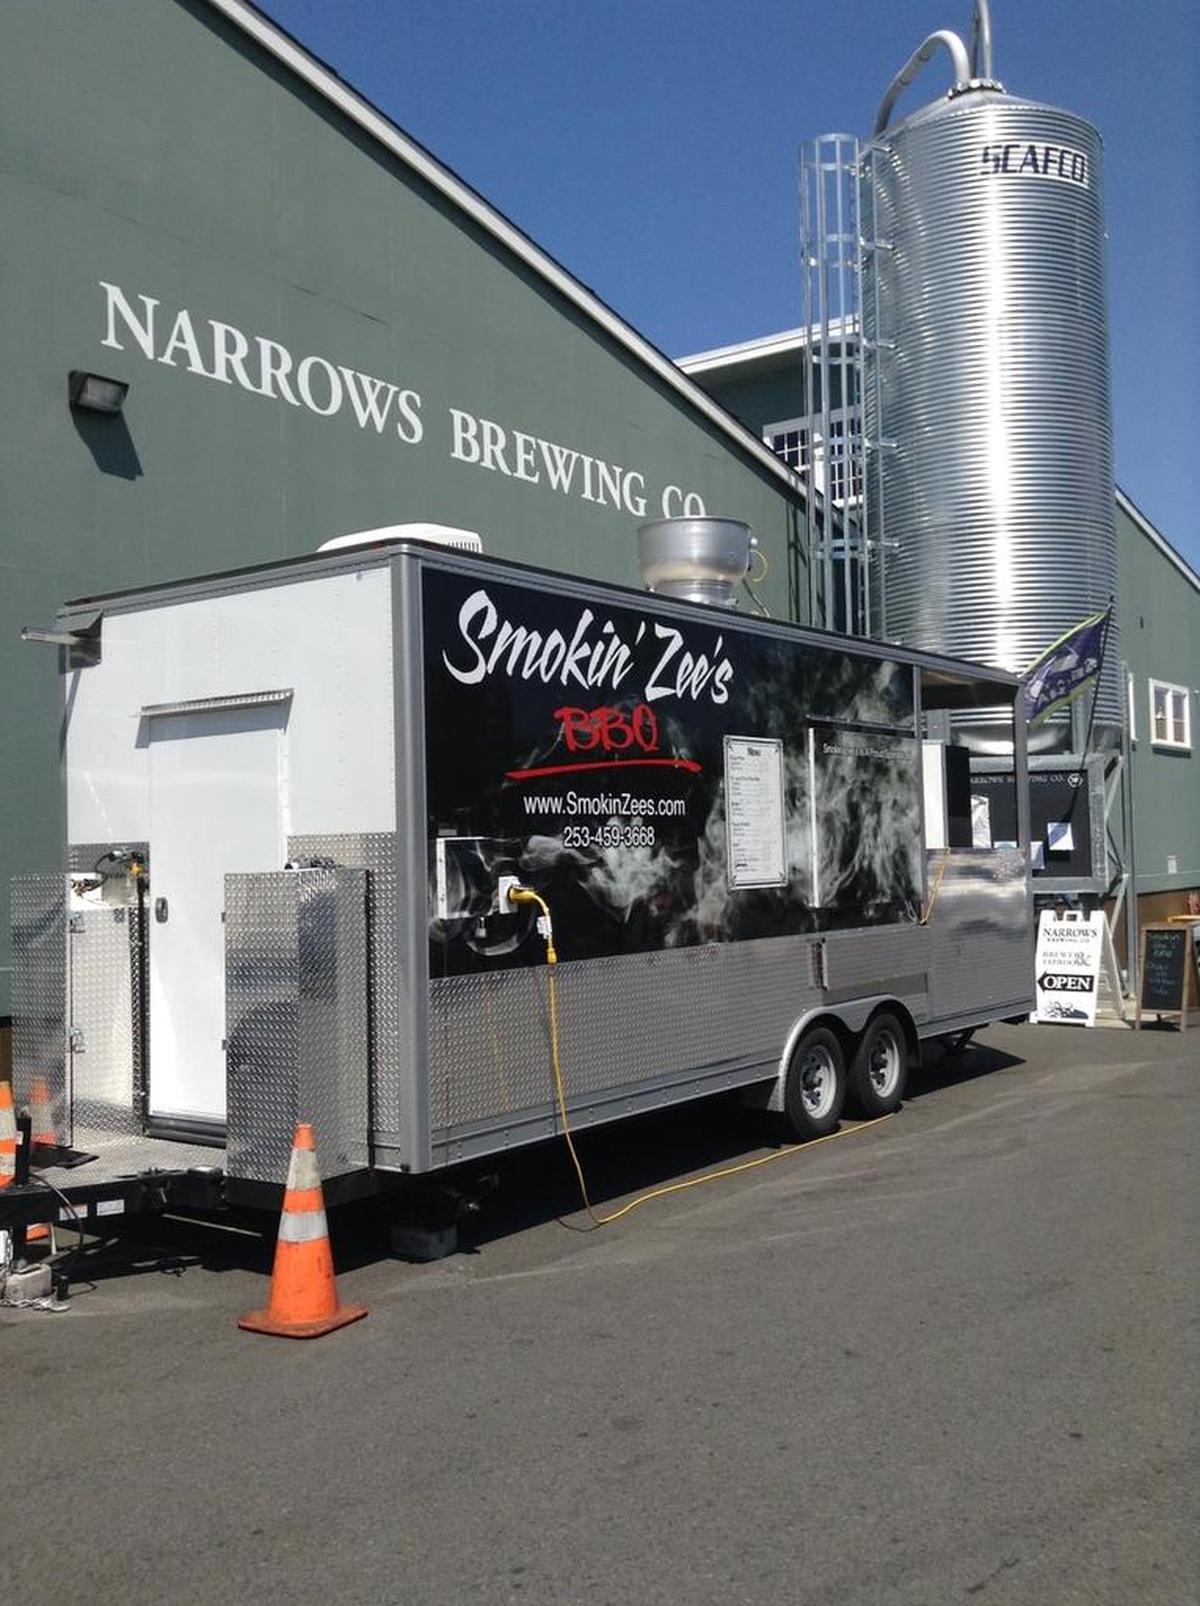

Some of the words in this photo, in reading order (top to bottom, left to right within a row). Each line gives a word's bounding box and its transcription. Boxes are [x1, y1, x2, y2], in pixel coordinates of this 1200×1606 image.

[981, 144, 1086, 183] SCAFCO
[99, 281, 424, 445] NARROWS
[450, 407, 648, 518] BREWING
[442, 588, 646, 690] Smokin'
[644, 622, 735, 705] Zee's
[553, 703, 661, 753] BBQ
[523, 792, 686, 817] www.SmokinZees.com
[563, 826, 655, 847] 253-459-3668
[1043, 927, 1098, 938] NARROWS
[1043, 975, 1091, 990] OPEN
